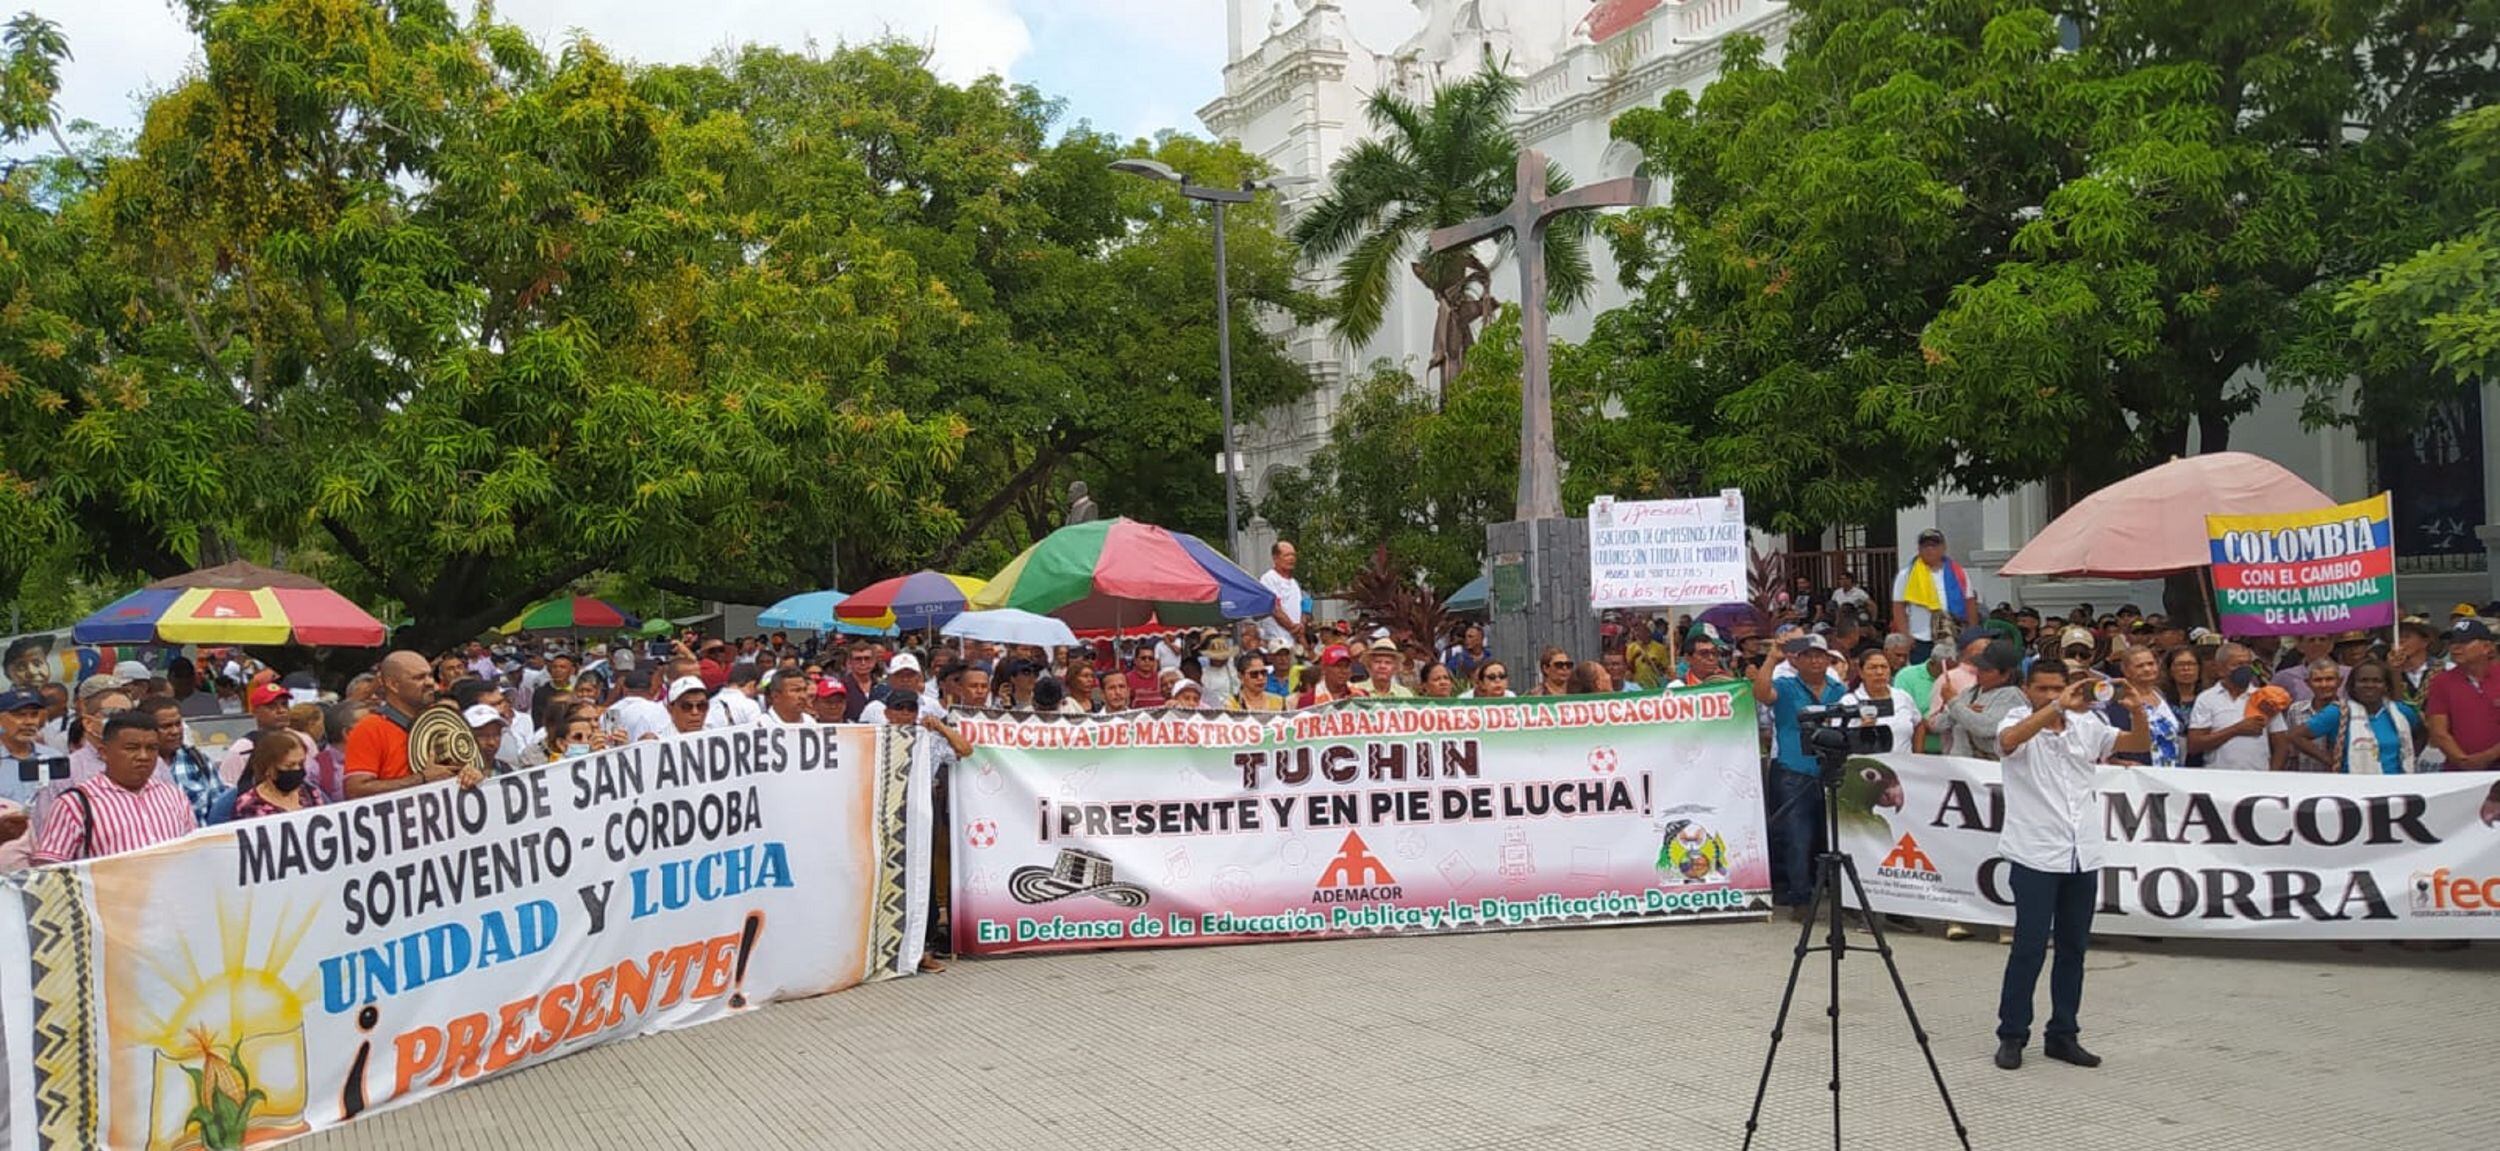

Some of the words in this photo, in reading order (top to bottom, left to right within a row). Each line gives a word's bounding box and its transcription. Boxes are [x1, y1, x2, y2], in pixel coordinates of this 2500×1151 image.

[2223, 516, 2376, 564] COLOMBIA
[2227, 588, 2302, 606] POTENCIA
[2306, 577, 2380, 602] MUNDIAL
[2241, 569, 2275, 586] CON
[2280, 568, 2297, 585] EL
[2300, 559, 2362, 584] CAMBIO
[2265, 608, 2286, 624] DE
[2289, 607, 2308, 624] LA
[2311, 603, 2351, 623] VIDA
[960, 719, 1091, 748] DIRECTIVA
[1097, 722, 1130, 747] DE
[1135, 720, 1262, 747] MAESTROS
[1274, 719, 1288, 742] Y
[1295, 706, 1481, 740] TRABAJADORES
[1485, 706, 1517, 731] DE
[1522, 703, 1555, 728] LA
[1559, 691, 1695, 726] EDUCACIÓN
[1700, 694, 1732, 718] DE
[1234, 739, 1481, 789] TUCHIN
[236, 787, 488, 887] MAGISTERIO
[500, 769, 552, 825] DE
[571, 748, 644, 810] SAN
[799, 726, 839, 771] DE
[1268, 799, 1291, 828] Y
[1308, 794, 1358, 826] EN
[1371, 790, 1430, 823] PIE
[1443, 787, 1493, 820] DE
[1930, 779, 2442, 847] AMACOR
[343, 826, 572, 936] SOTAVENTO
[605, 786, 763, 863] CÓRDOBA
[1877, 867, 1943, 883] ADEMACOR
[979, 920, 1009, 942] En
[1019, 915, 1121, 940] Defensa
[1131, 914, 1161, 936] de
[1171, 912, 1194, 935] la
[1203, 908, 1324, 933] Educación
[1334, 904, 1421, 928] Publica
[1429, 908, 1442, 928] y
[1448, 901, 1473, 919] la
[1482, 889, 1637, 926] Dignificación
[1647, 886, 1744, 910] Docente
[1312, 885, 1403, 904] ADEMACOR
[1976, 857, 2399, 922] CTORRA
[318, 898, 560, 1015] UNIDAD
[578, 880, 614, 937] Y
[629, 841, 795, 921] LUCHA
[338, 911, 765, 1122] ¡PRESENTE!
